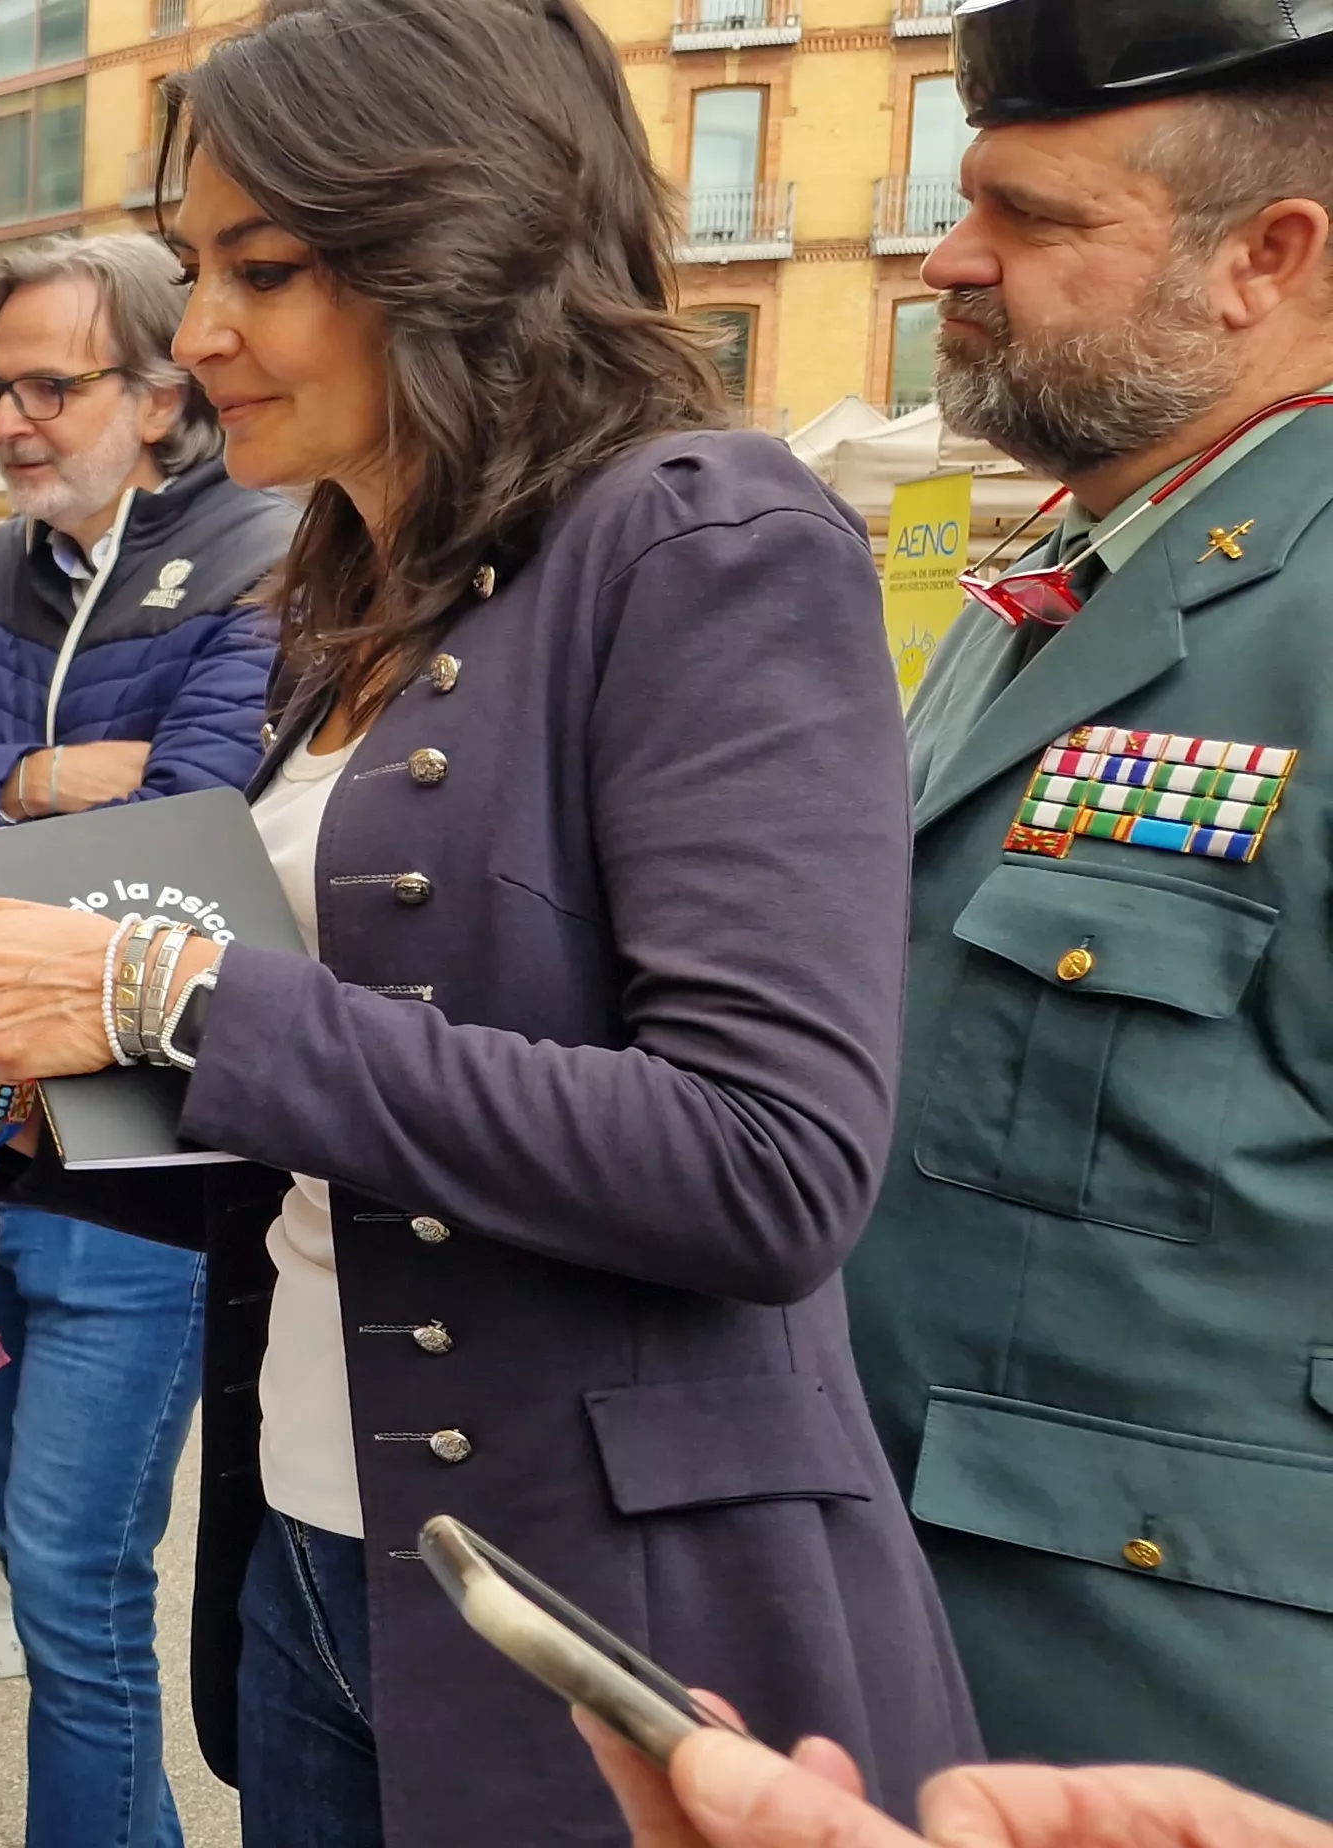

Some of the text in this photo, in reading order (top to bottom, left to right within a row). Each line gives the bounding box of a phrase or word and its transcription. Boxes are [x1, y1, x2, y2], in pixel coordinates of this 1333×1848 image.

[893, 520, 959, 560] AENO
[113, 879, 149, 901] la
[156, 886, 235, 946] psico
